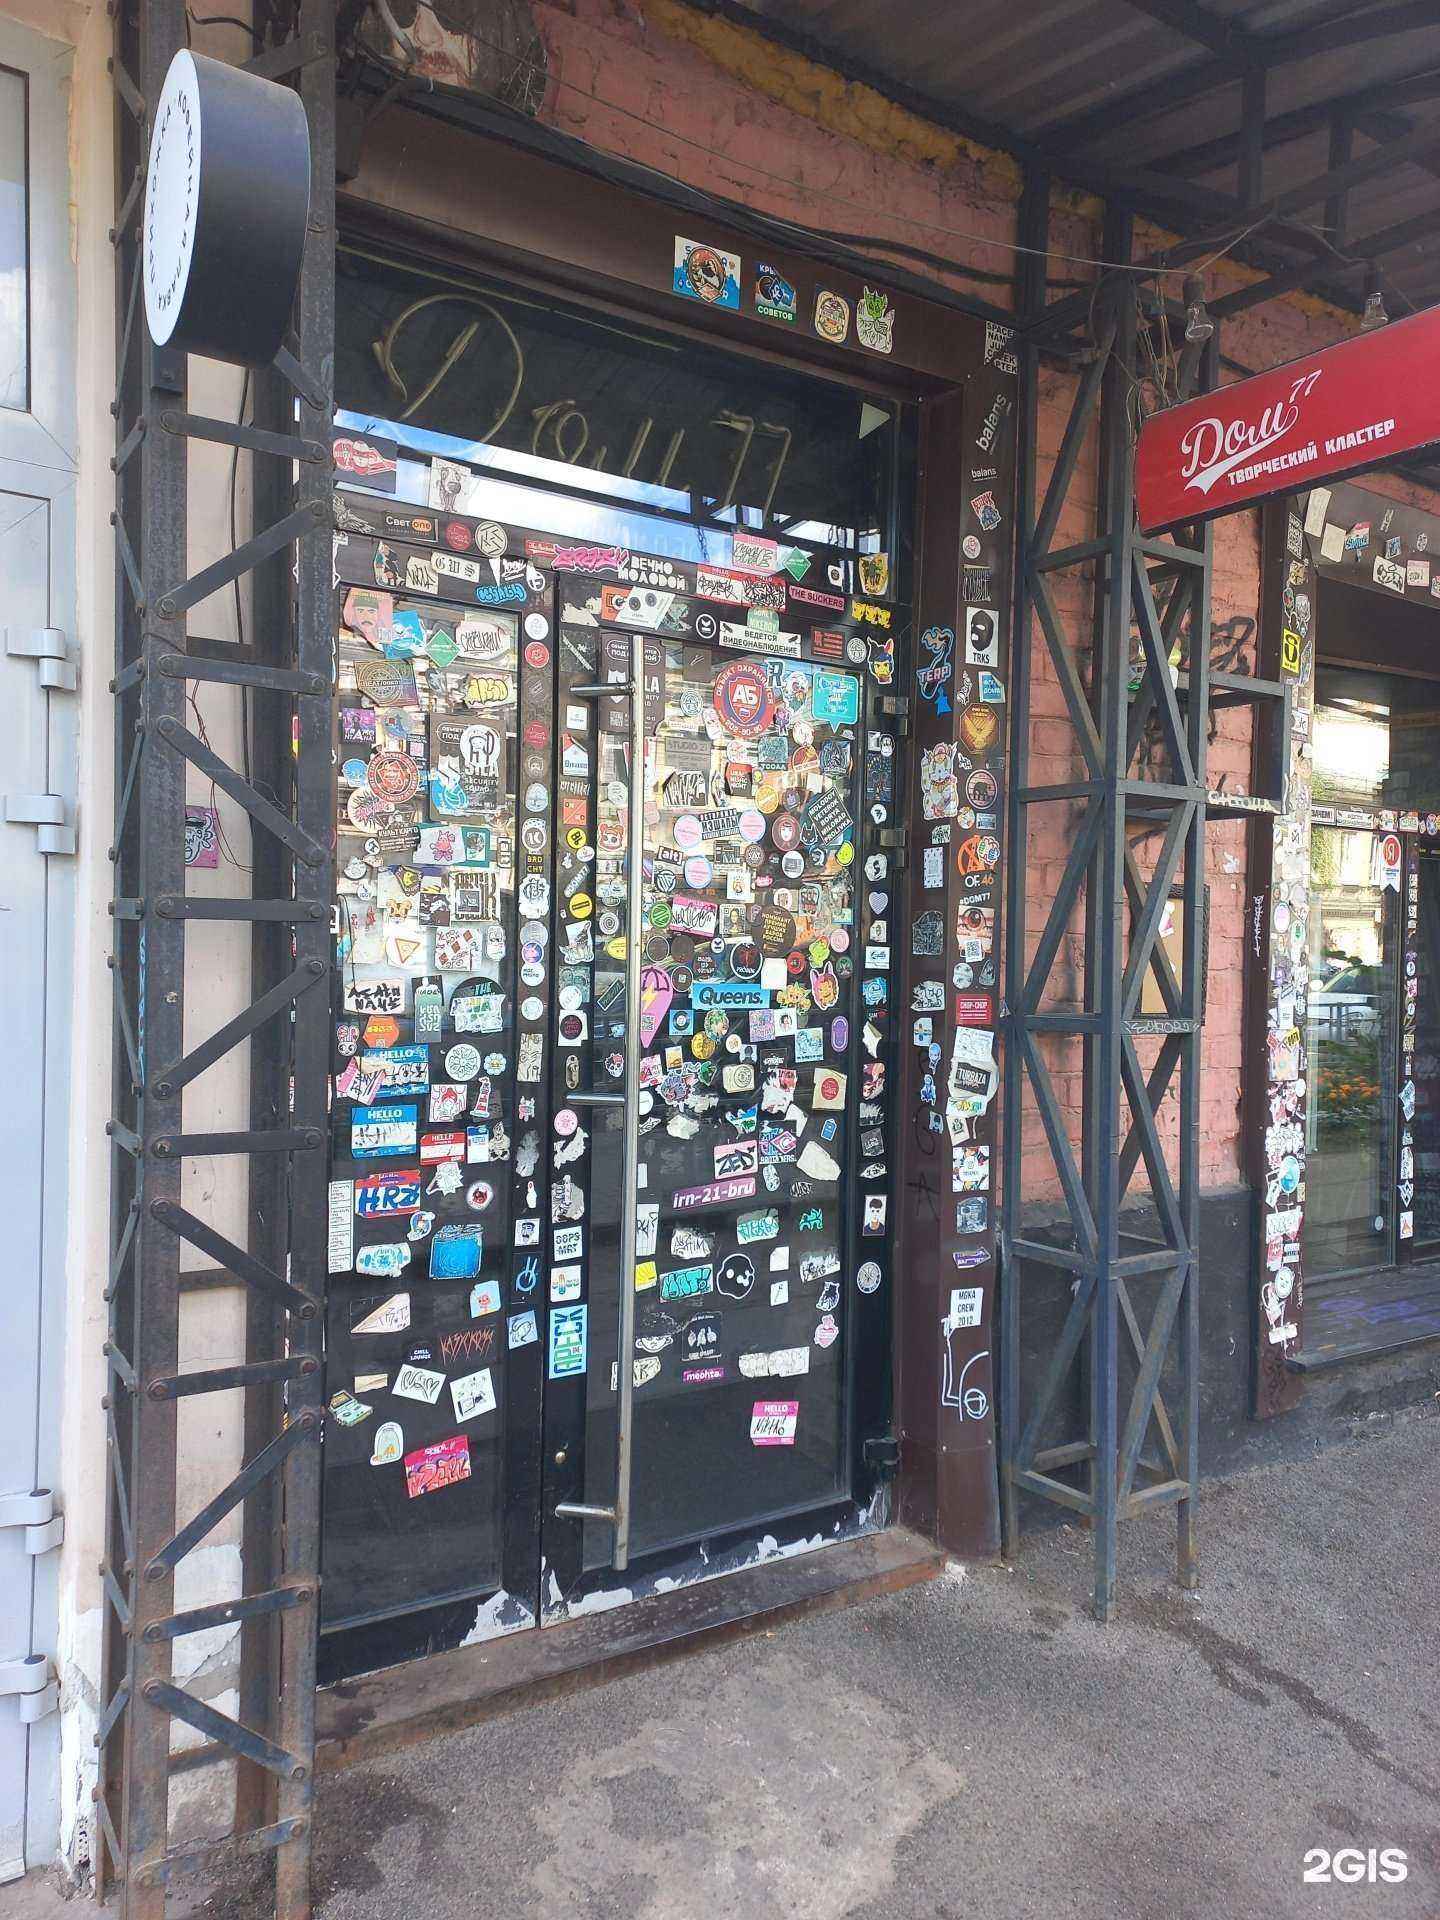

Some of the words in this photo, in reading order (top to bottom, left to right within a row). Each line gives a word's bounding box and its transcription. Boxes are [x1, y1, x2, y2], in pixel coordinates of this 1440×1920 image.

[758, 305, 793, 321] СОВЕТОВ
[976, 394, 1007, 451] balans
[1181, 402, 1298, 478] Дом
[1289, 369, 1322, 404] 77
[1228, 441, 1318, 486] ТВОРЧЕСКИЙ
[1325, 418, 1396, 455] КЛАСТЕР
[631, 556, 673, 574] ВЕЧНО
[618, 568, 686, 590] МОЛОДОЙ
[791, 588, 806, 599] THE
[807, 592, 844, 608] SUCKERS
[723, 636, 798, 654] ВИДЕОНАБЛЮДЕНИЕ
[973, 652, 990, 664] TRKS
[809, 790, 836, 814] MOLODOY
[814, 798, 839, 821] VETEROK
[821, 812, 846, 836] MILORAD
[824, 818, 851, 843] PROLIVKA
[698, 986, 763, 1005] Queens.
[379, 1050, 414, 1059] HELLO
[367, 1110, 403, 1119] HELLO
[673, 1180, 755, 1209] irn-21-bru
[957, 1304, 974, 1313] CREW
[958, 1316, 974, 1325] 2012
[764, 1404, 789, 1413] HELLO
